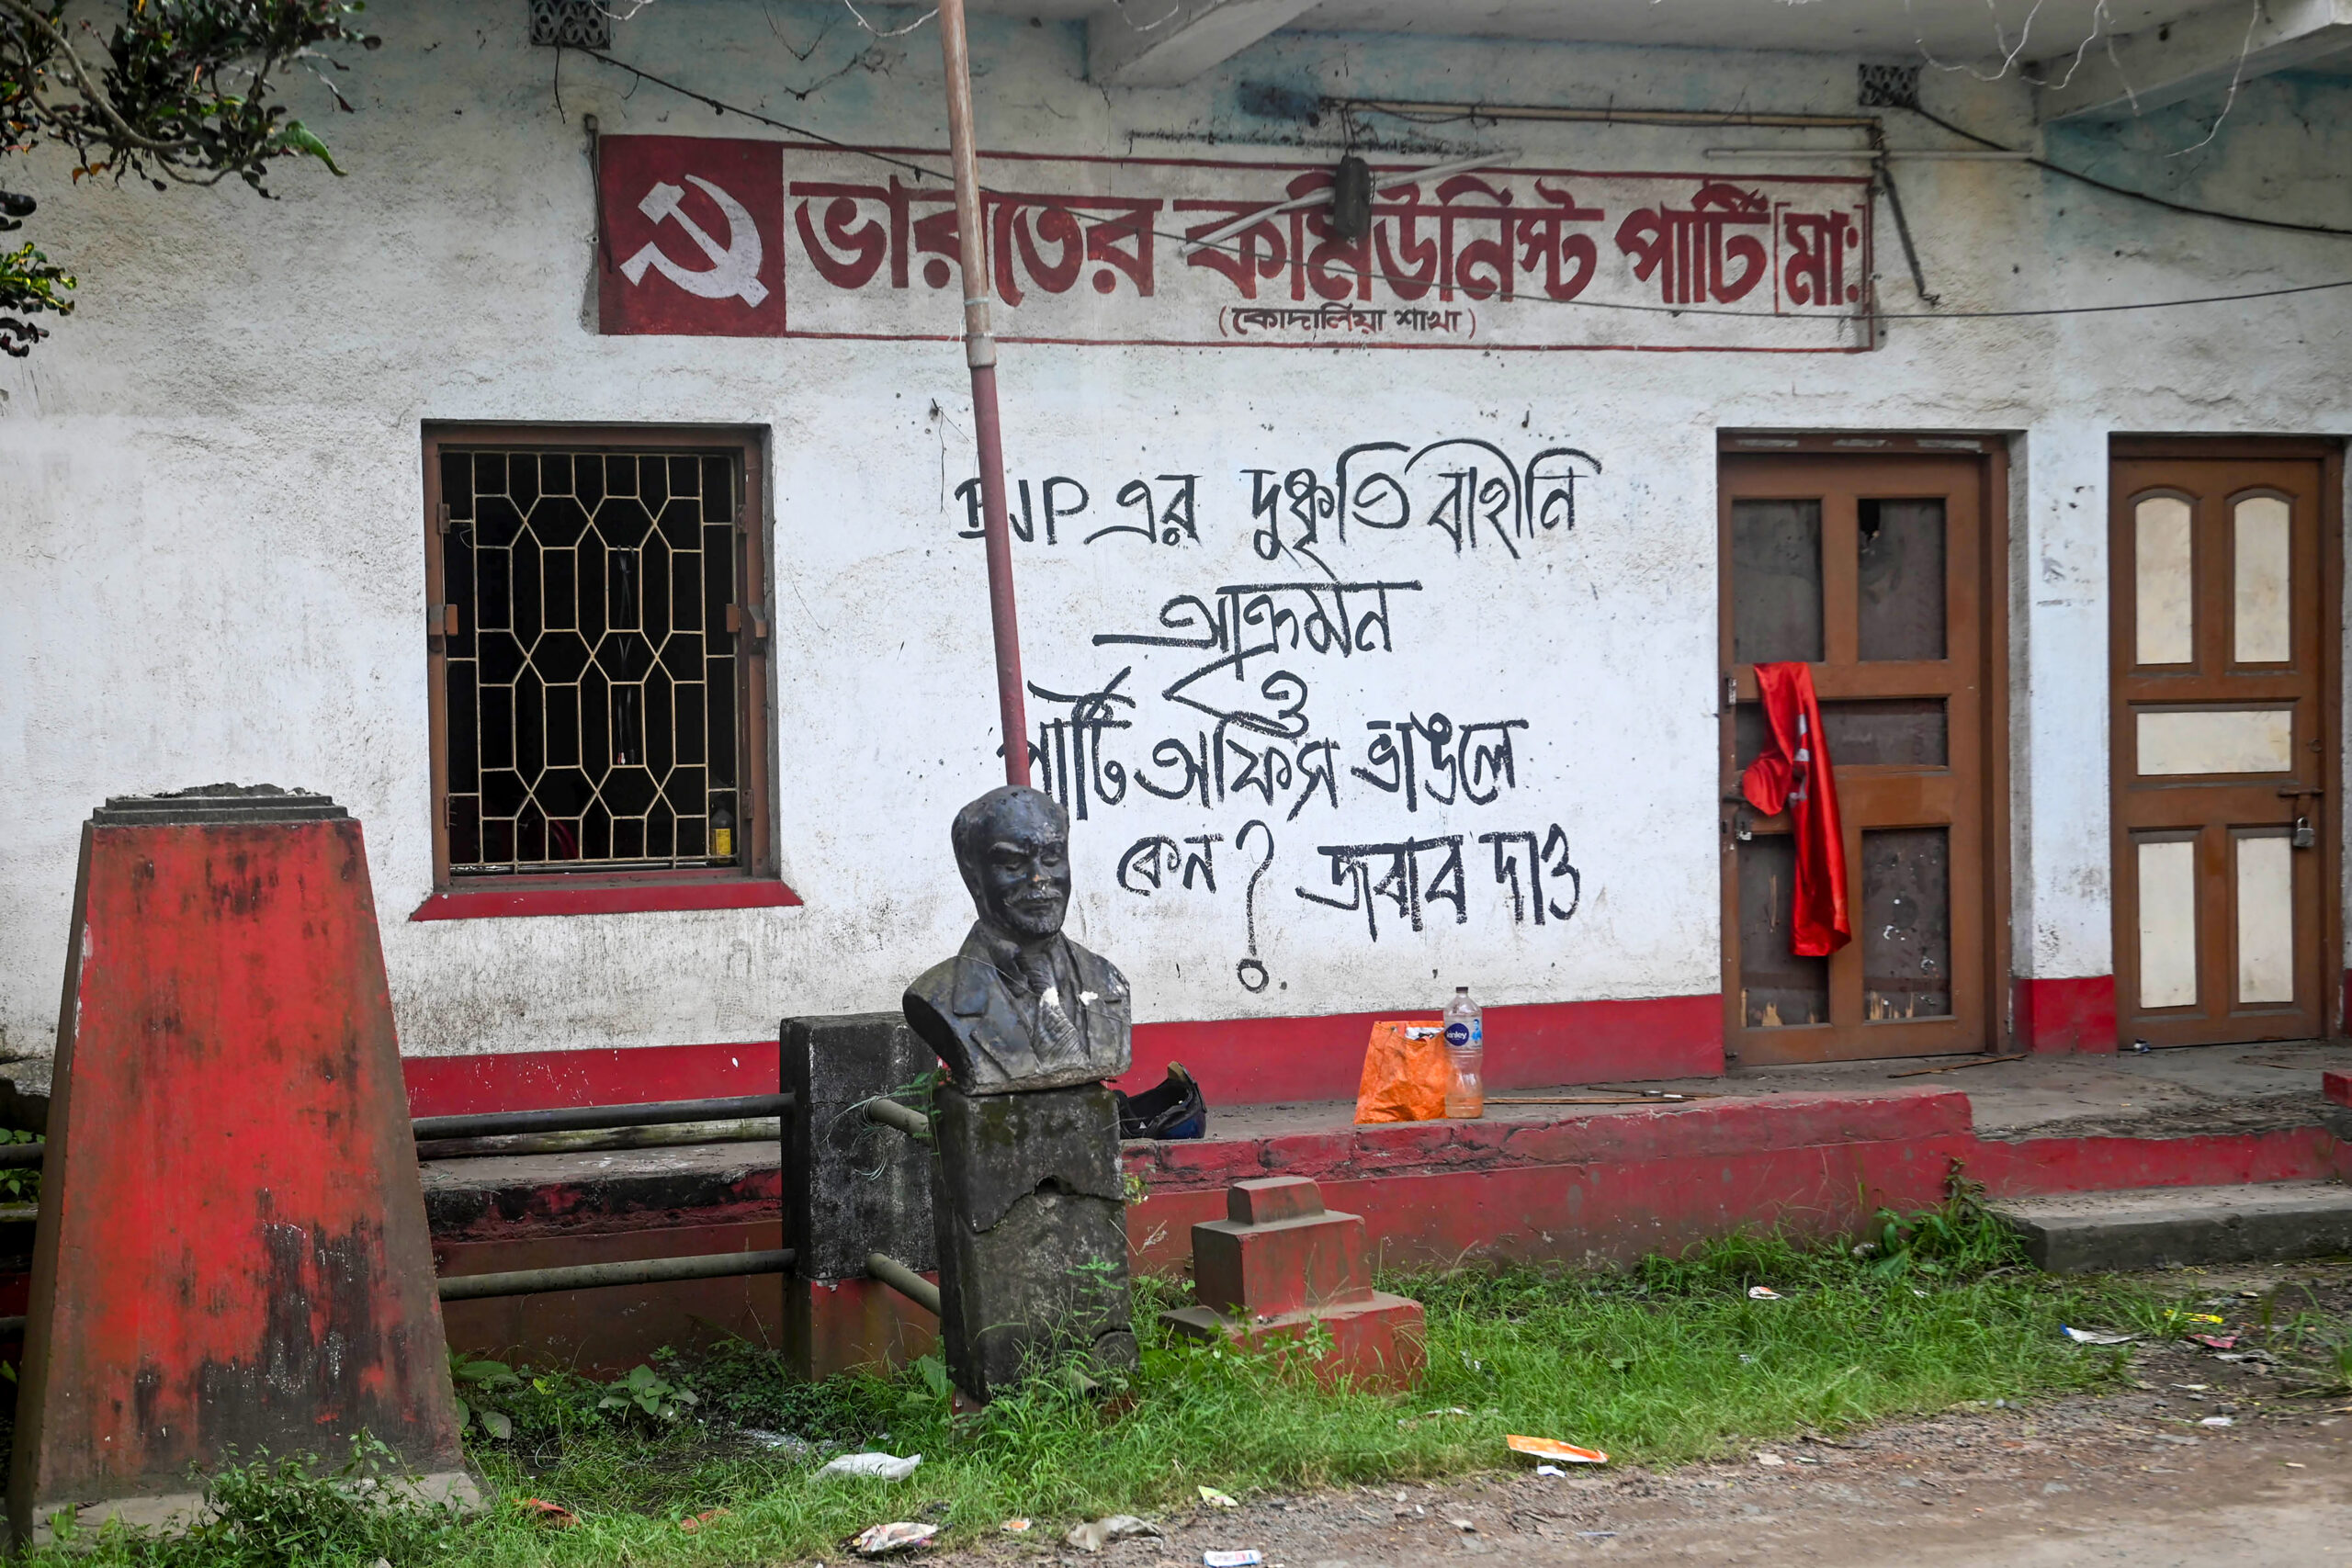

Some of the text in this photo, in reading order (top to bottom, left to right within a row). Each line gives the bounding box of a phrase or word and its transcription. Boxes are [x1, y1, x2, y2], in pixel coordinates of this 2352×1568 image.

[788, 175, 1162, 308] ভারতের
[1172, 172, 1604, 304] কমিউনিস্ট
[1614, 181, 1770, 304] পার্টি
[1084, 474, 1204, 548] এর
[1477, 822, 1581, 926] দাও
